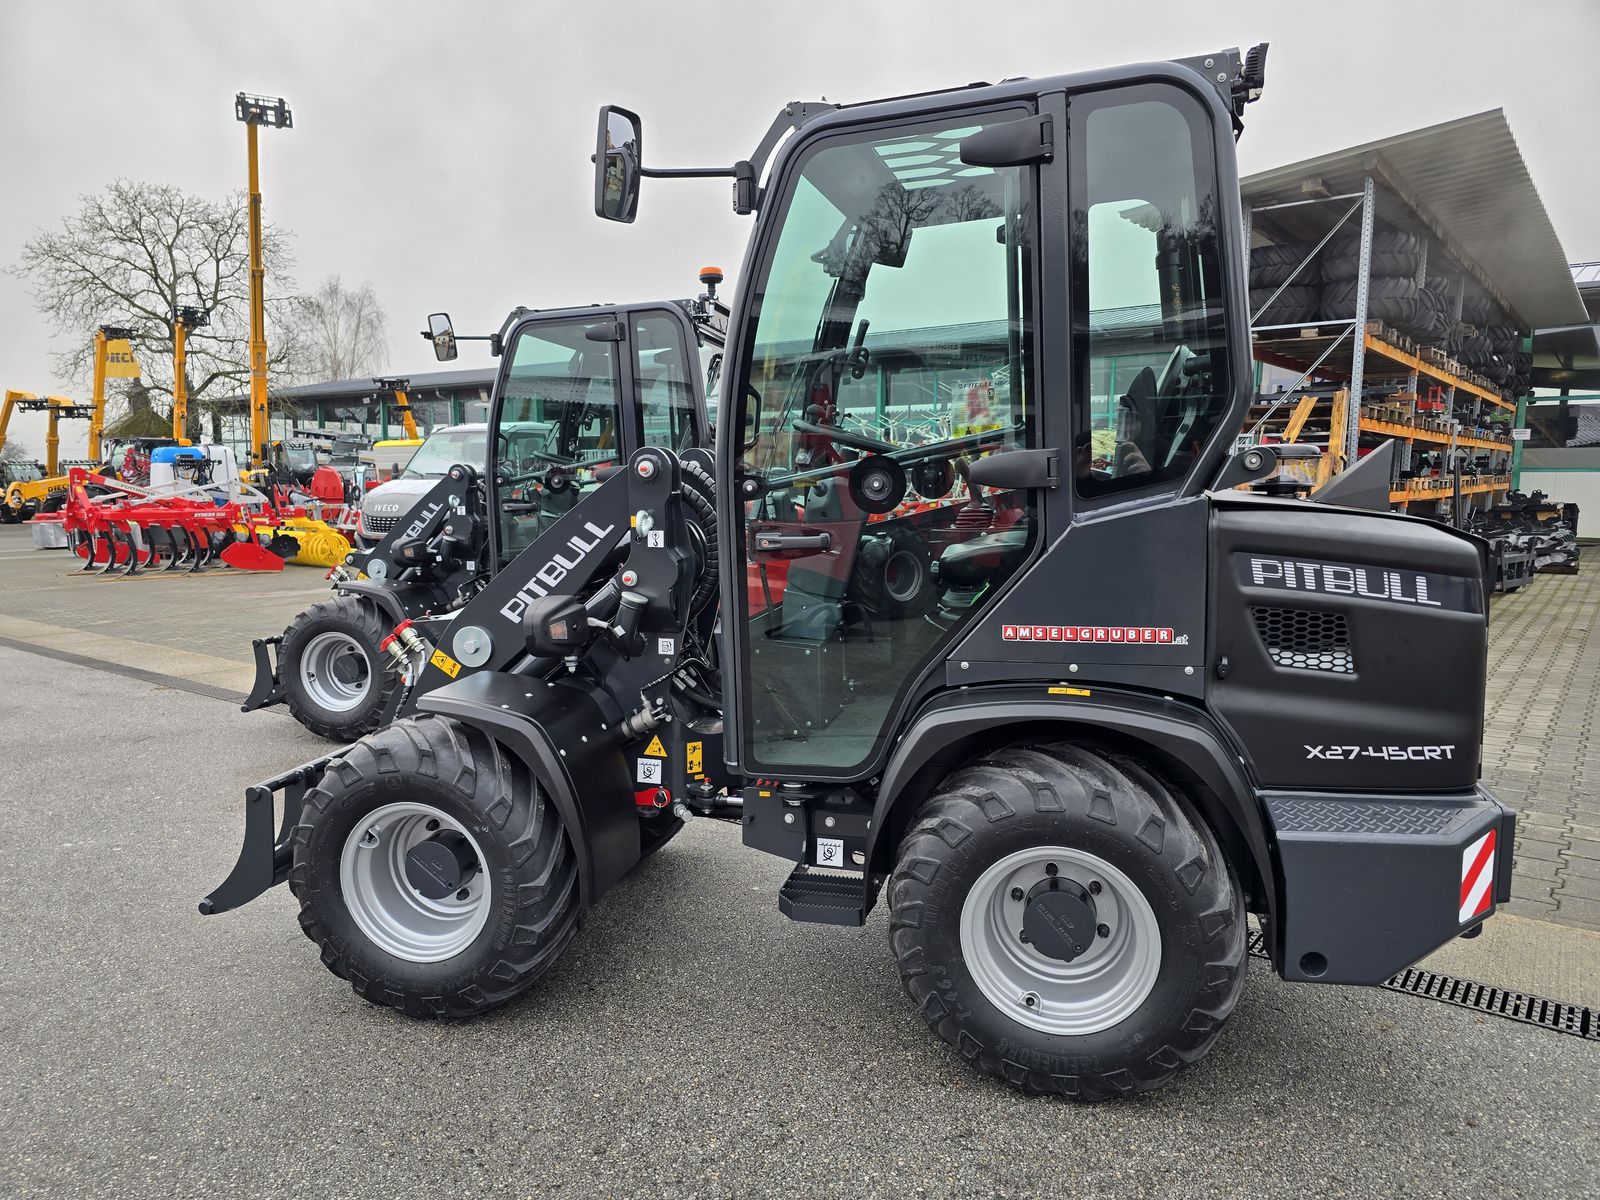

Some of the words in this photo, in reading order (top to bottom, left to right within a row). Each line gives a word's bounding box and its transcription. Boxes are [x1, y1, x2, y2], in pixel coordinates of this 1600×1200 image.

[374, 504, 399, 512] IVECO
[400, 502, 444, 540] TBULL
[500, 521, 615, 624] PITBULL
[1251, 558, 1441, 606] PITBULL
[1304, 744, 1455, 761] X27-45CRT
